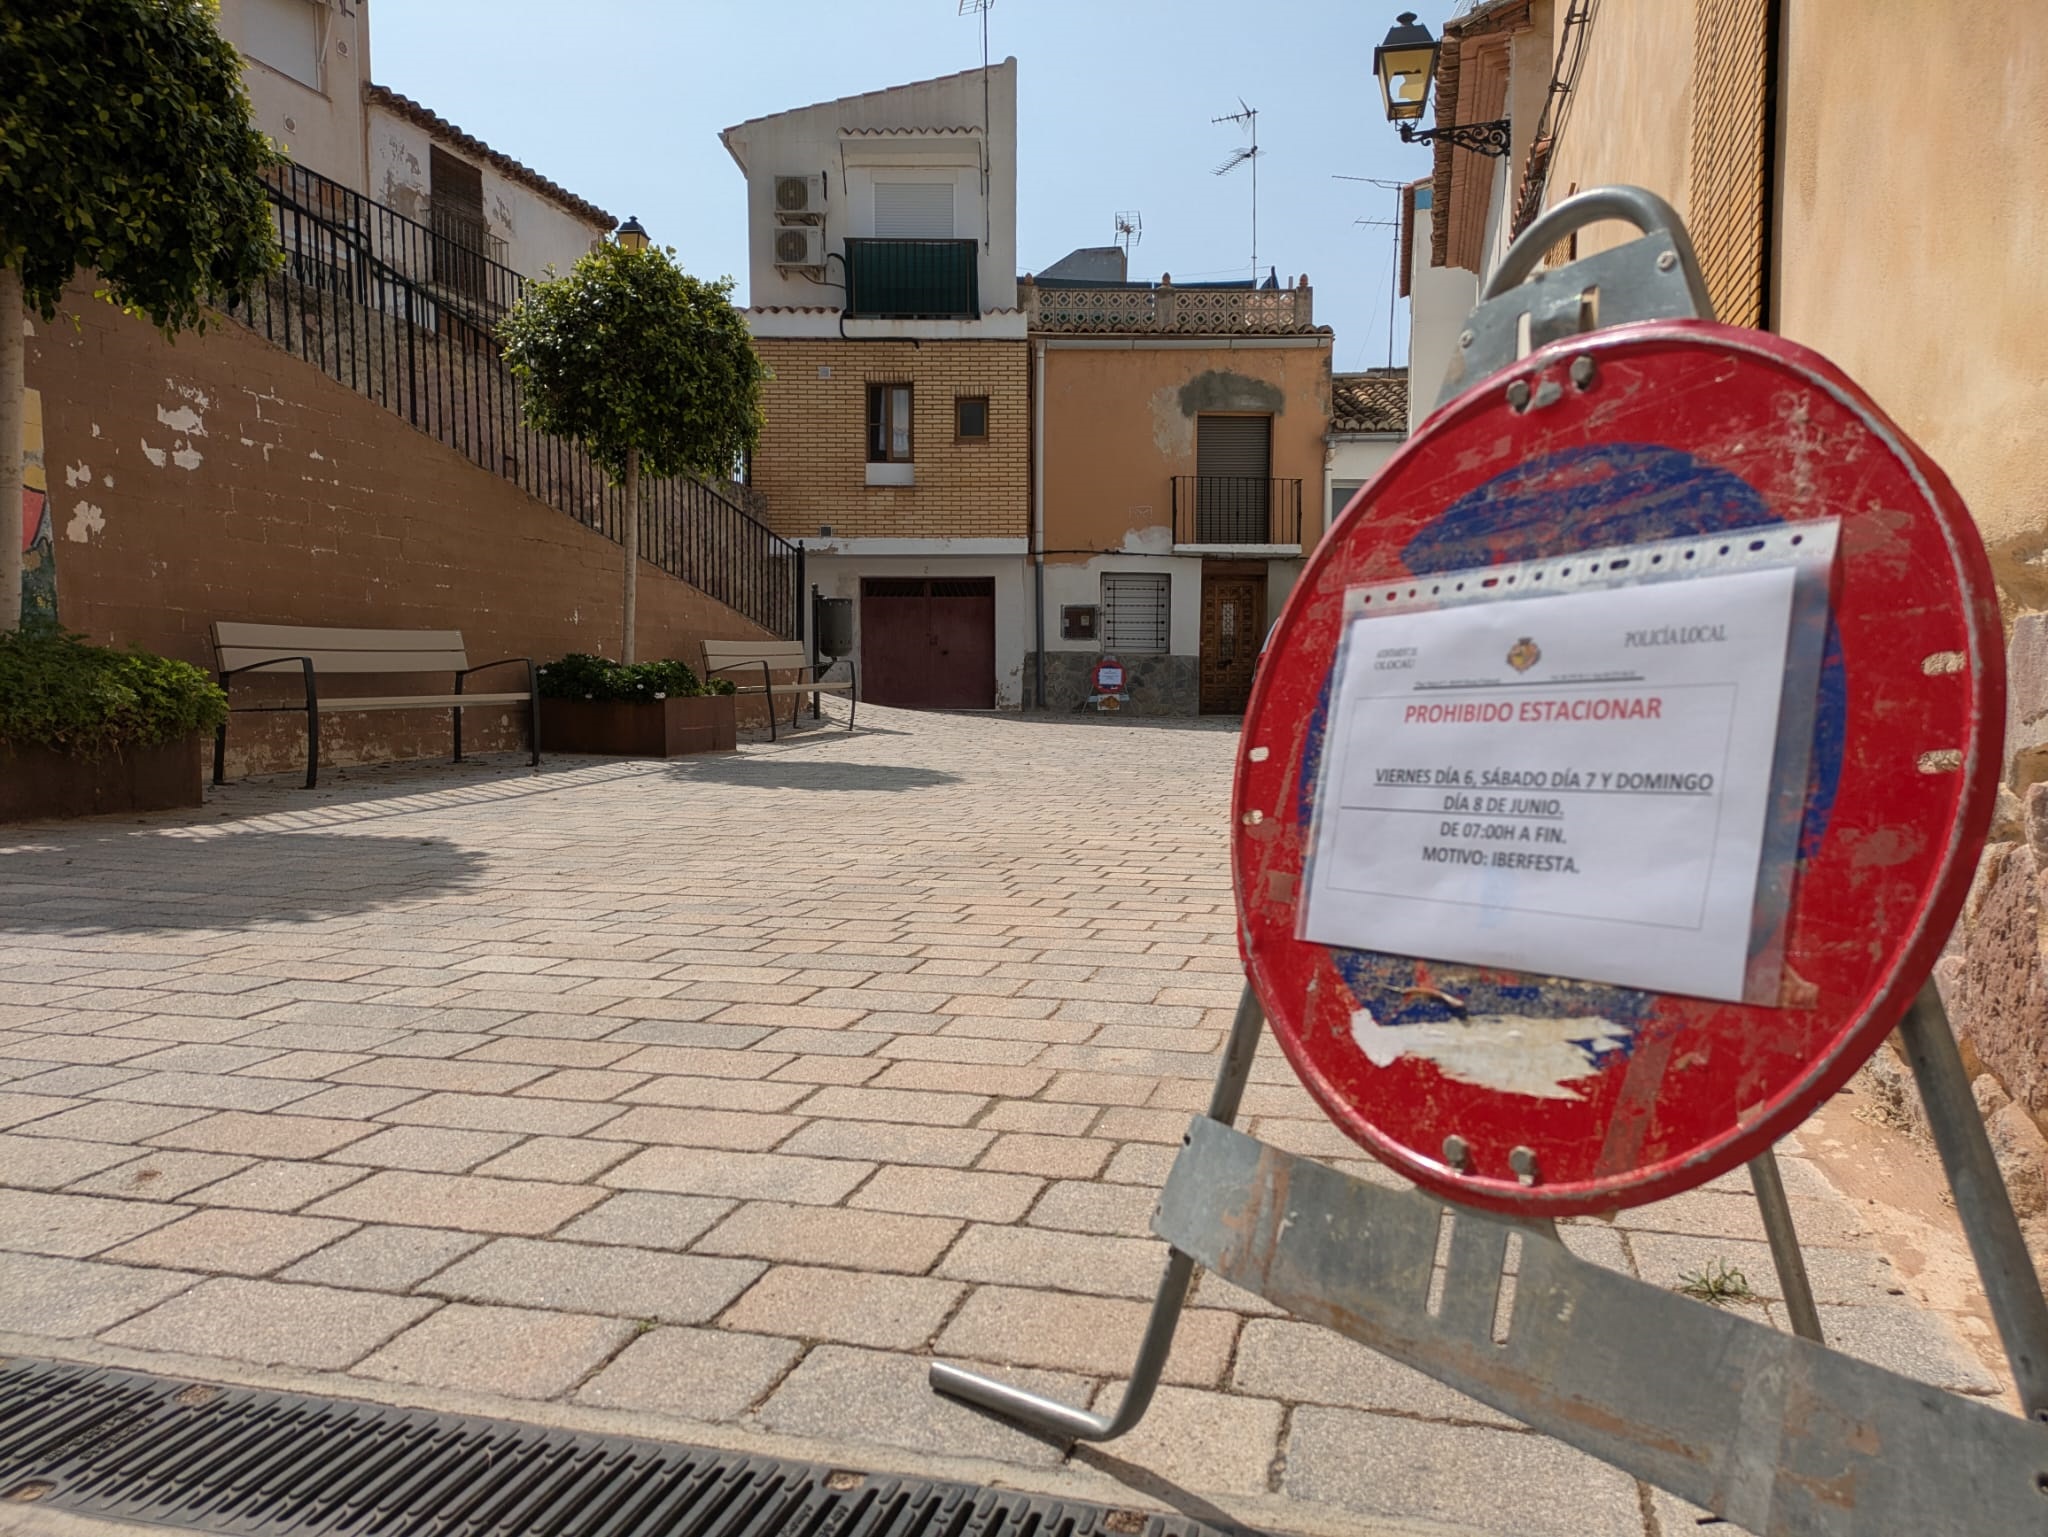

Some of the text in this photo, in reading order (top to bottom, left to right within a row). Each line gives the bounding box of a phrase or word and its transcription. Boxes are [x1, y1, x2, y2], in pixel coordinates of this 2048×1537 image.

[1624, 624, 1726, 648] POLICÍA LOCAL
[1404, 697, 1662, 723] PROHIBIDO ESTACIONAR
[1376, 766, 1714, 791] VIERNES DÍA 6, SÁBADO DÍA 7 Y DOMINGO
[1443, 792, 1564, 816] DÍA 8 DE JUNIO.
[1440, 821, 1567, 844] DE 07:00H A FIN.
[1421, 846, 1580, 874] MOTIVO: IBERFESTA.
